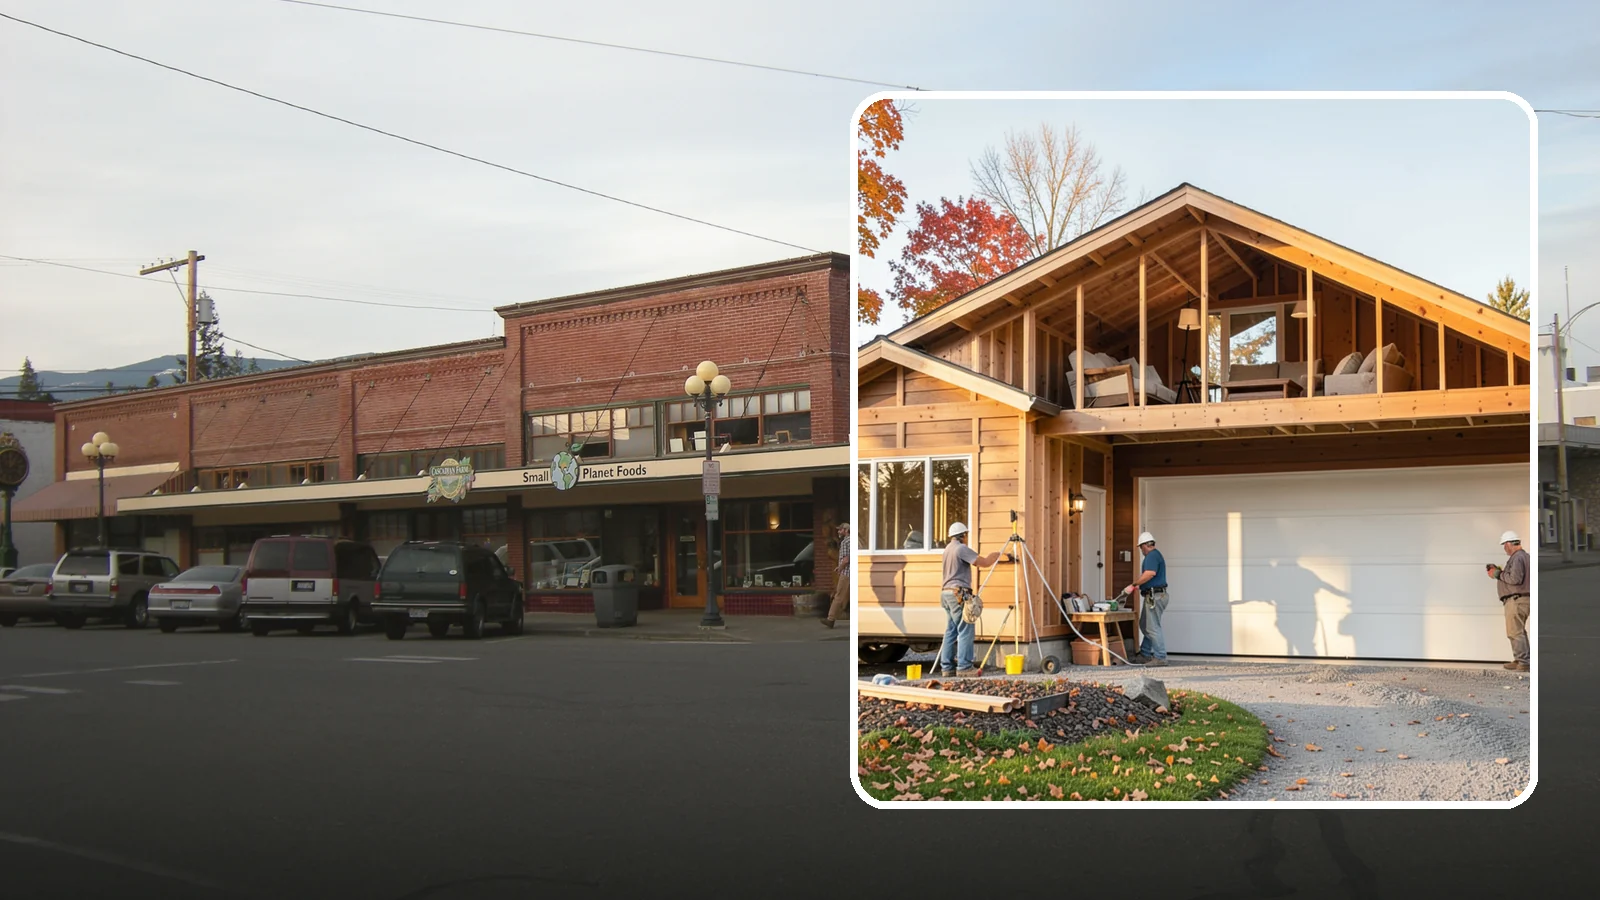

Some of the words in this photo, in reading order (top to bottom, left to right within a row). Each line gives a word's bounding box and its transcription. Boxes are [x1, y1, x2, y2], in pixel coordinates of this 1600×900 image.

[523, 471, 549, 483] Small
[583, 467, 614, 480] Planet
[617, 464, 647, 477] Foods
